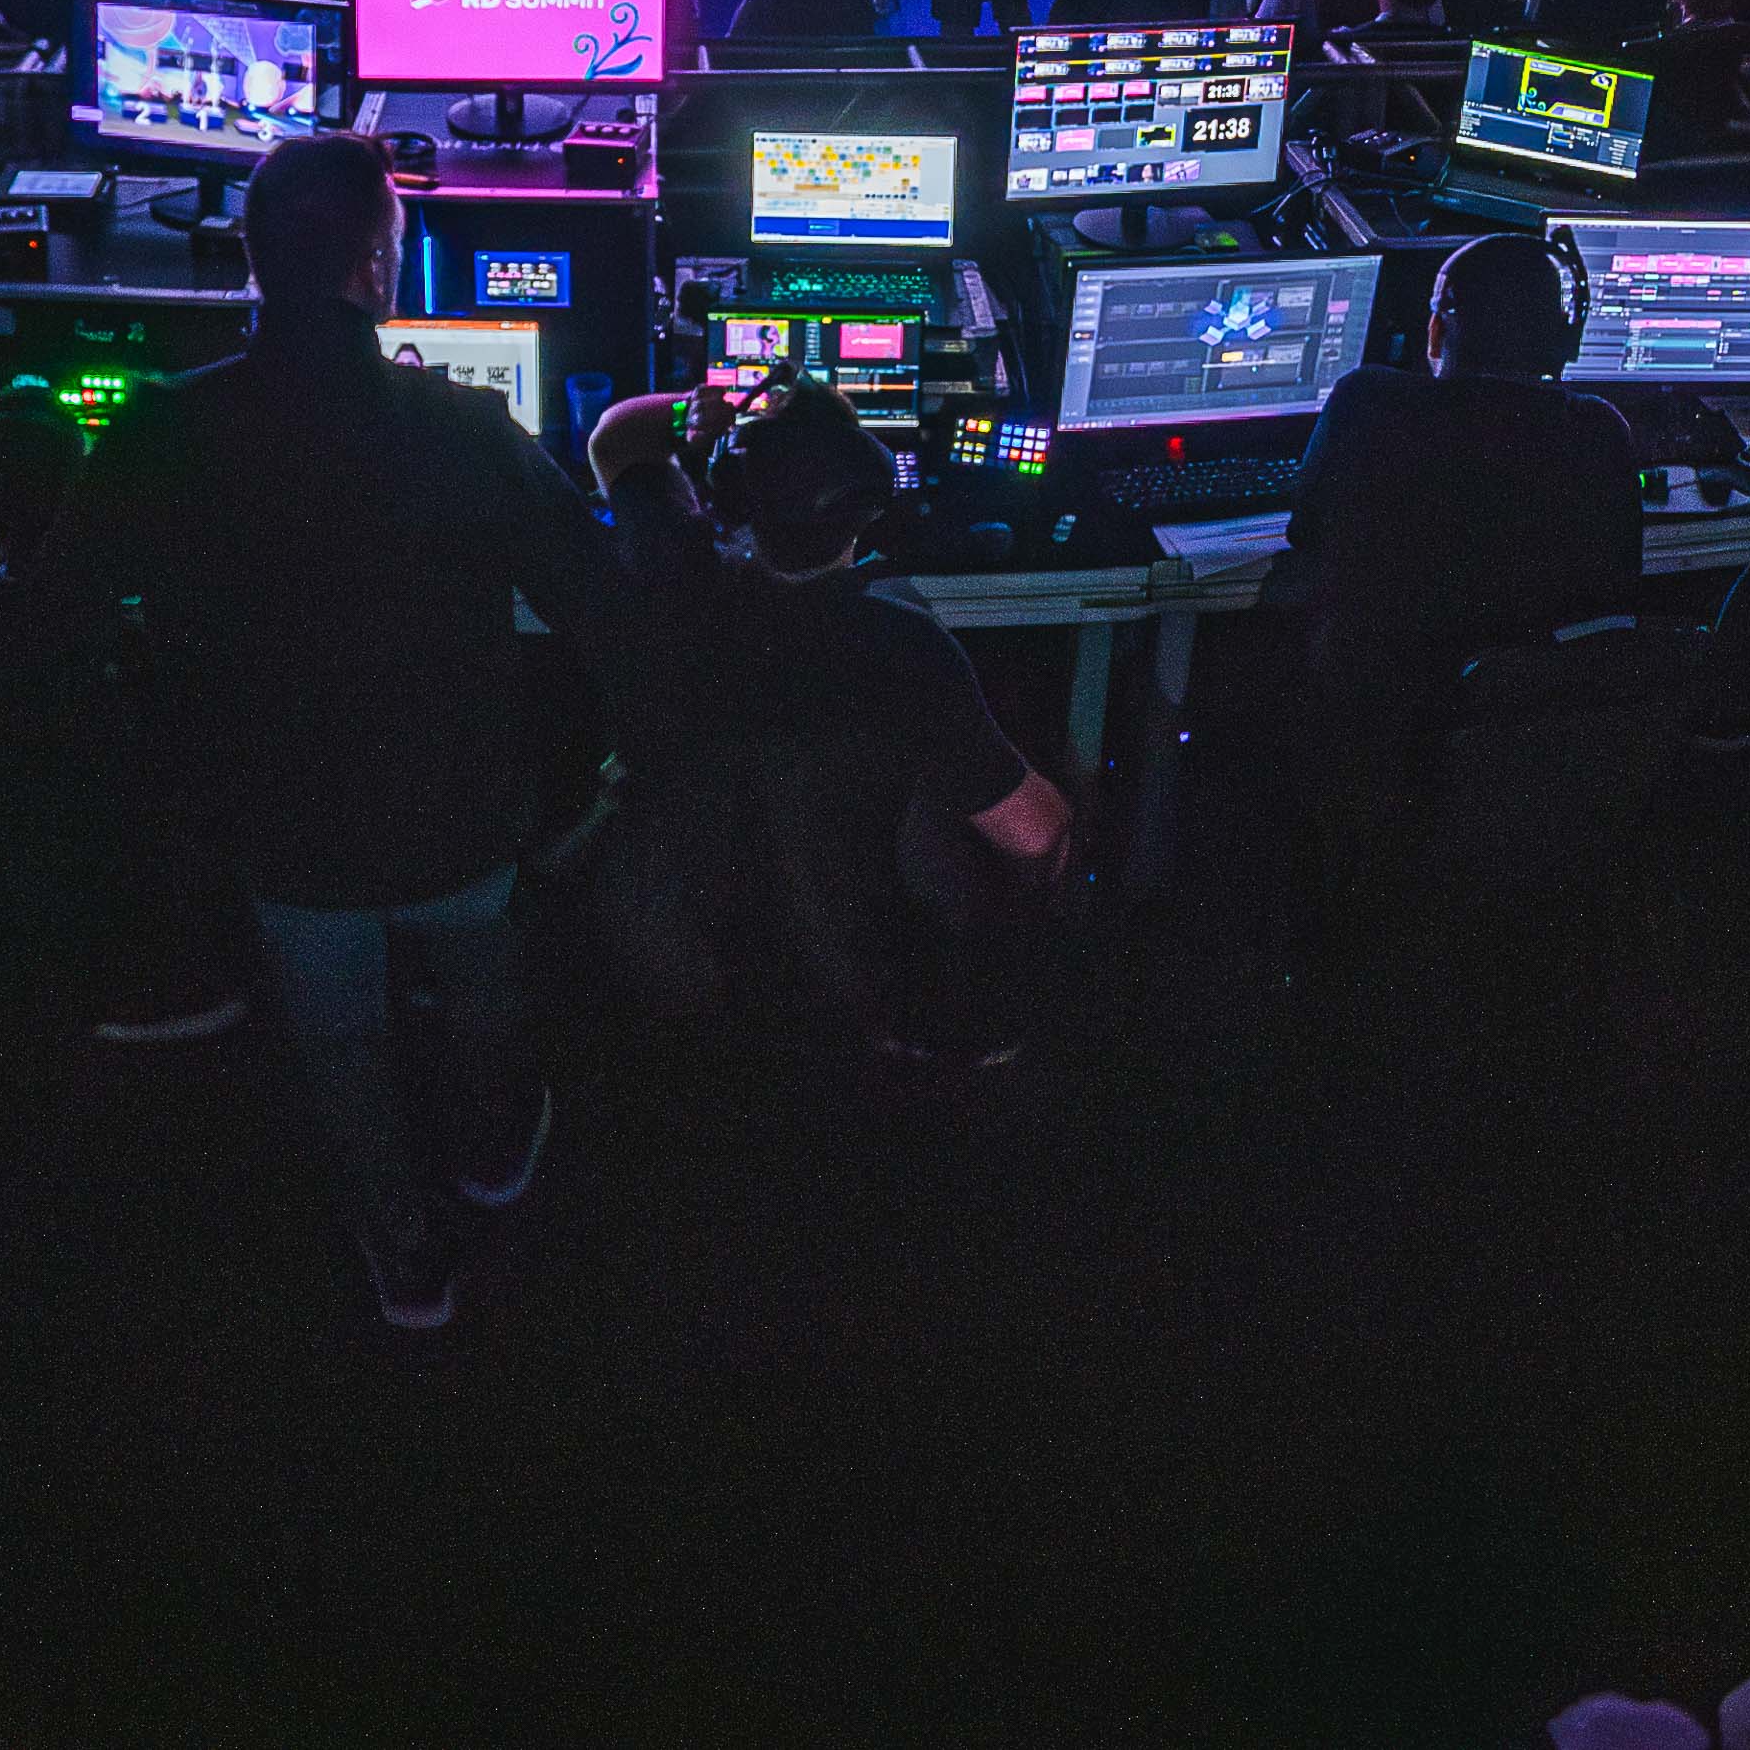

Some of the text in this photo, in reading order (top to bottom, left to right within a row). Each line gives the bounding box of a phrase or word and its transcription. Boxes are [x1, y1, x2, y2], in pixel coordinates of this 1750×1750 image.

[133, 101, 152, 126] 2
[194, 109, 209, 132] 1
[1191, 116, 1252, 143] 21:38
